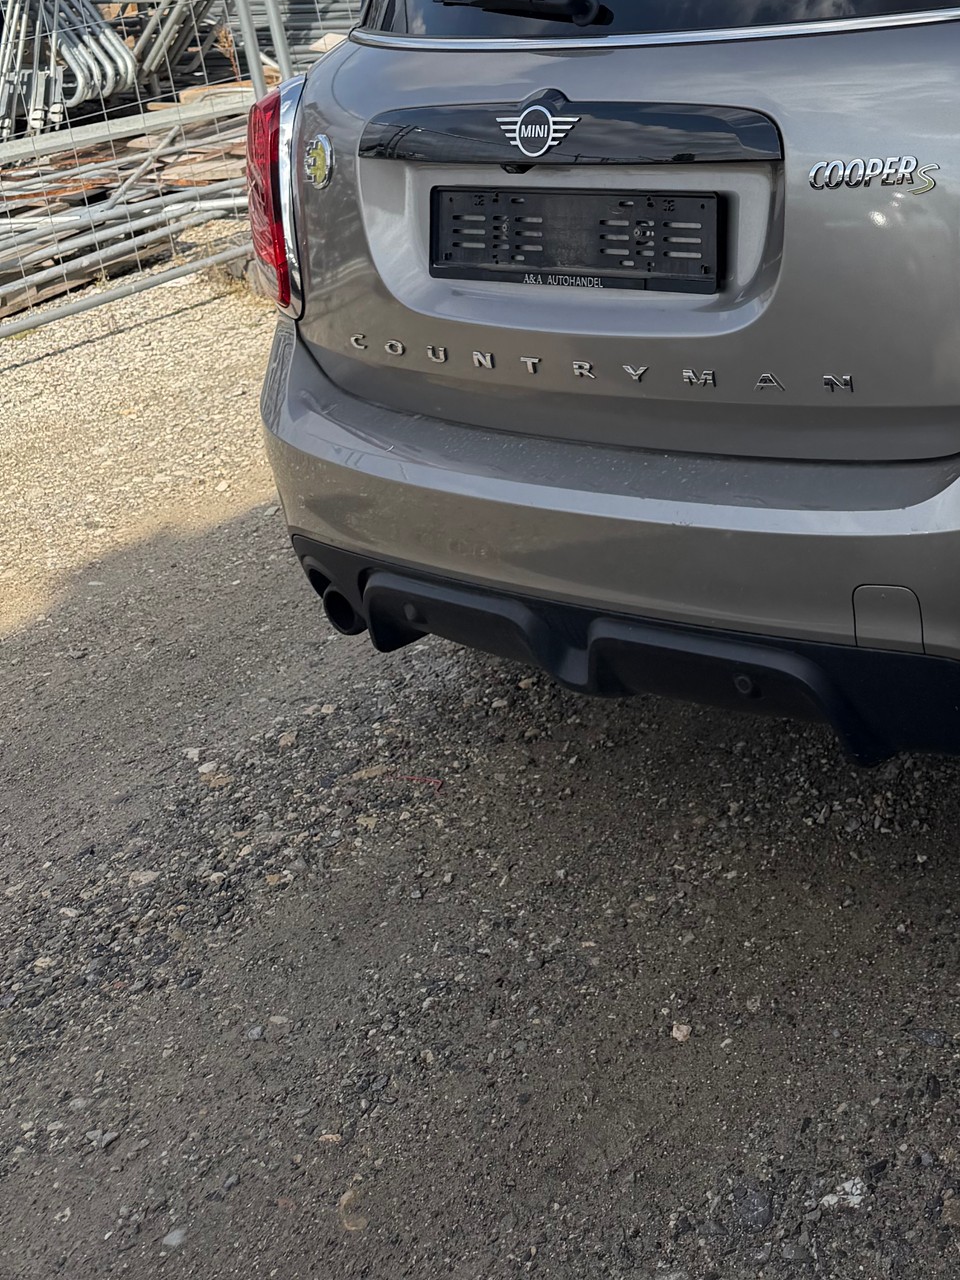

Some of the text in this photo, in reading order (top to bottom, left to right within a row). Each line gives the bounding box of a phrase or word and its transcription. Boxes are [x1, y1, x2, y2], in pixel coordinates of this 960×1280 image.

[520, 124, 549, 138] MINI
[808, 155, 940, 195] COOPER S
[523, 273, 604, 288] A&A AUTOHANDEL
[349, 333, 855, 393] COUNTRYMAN
